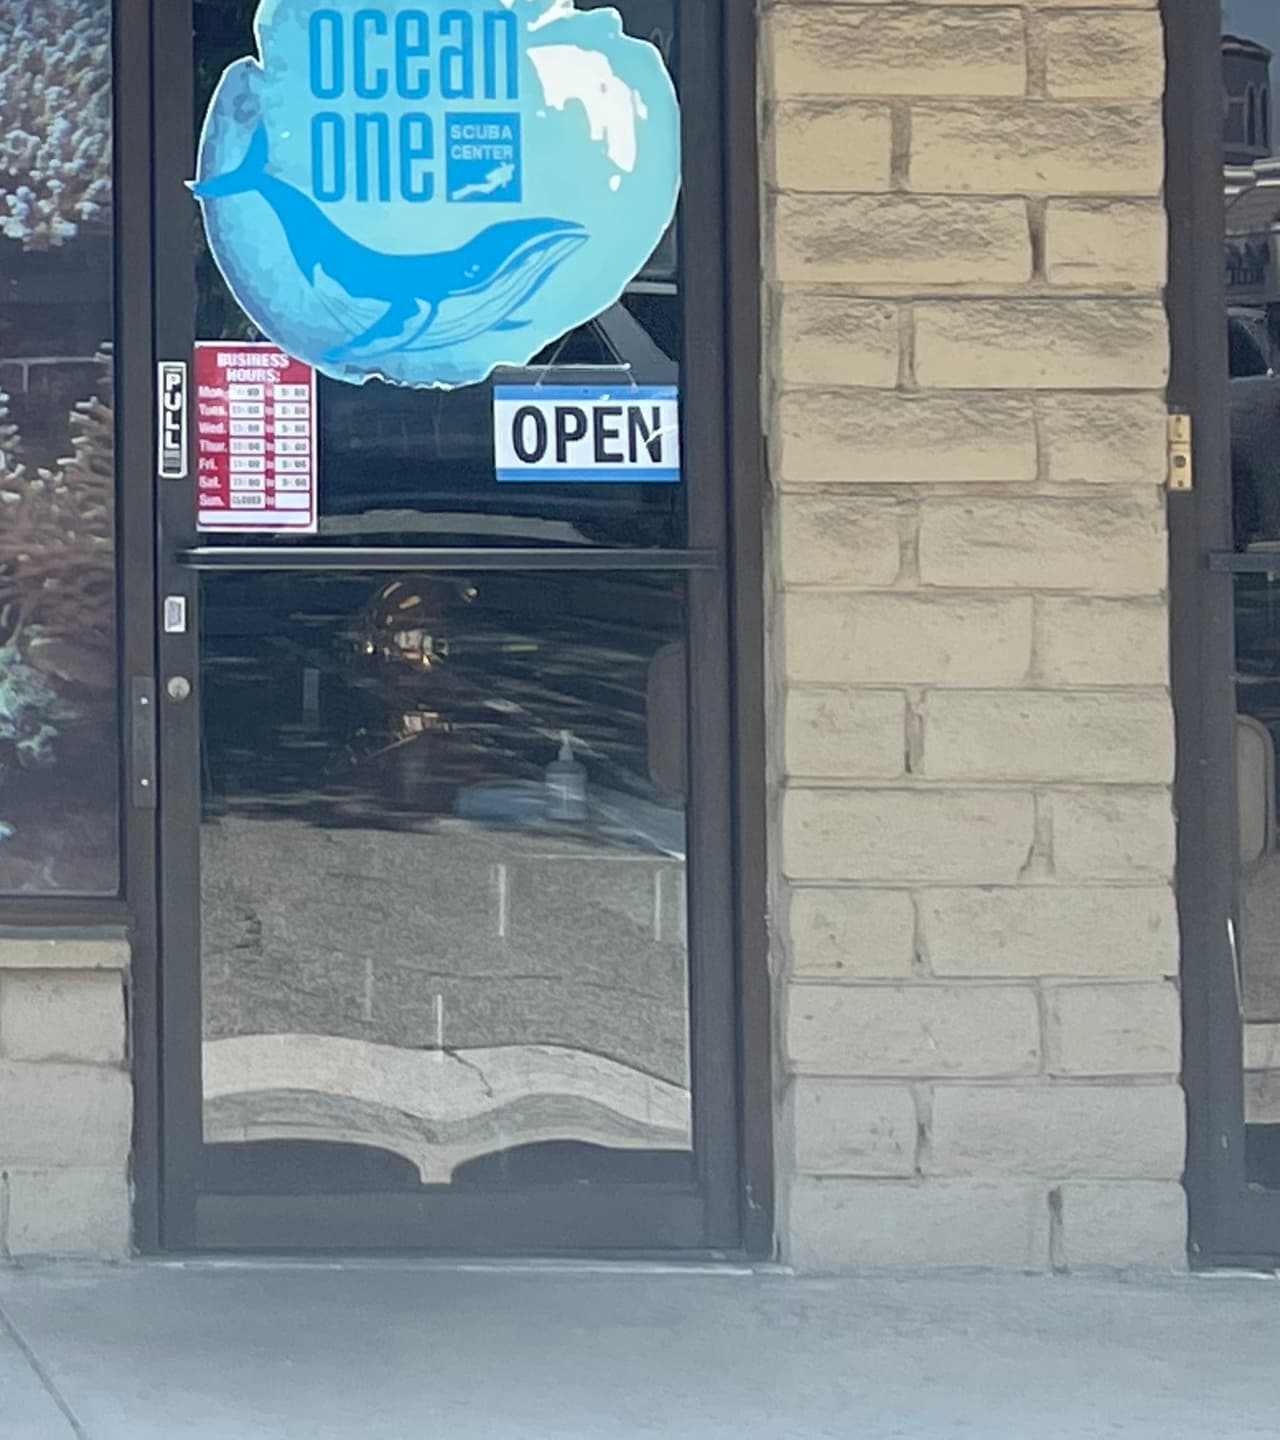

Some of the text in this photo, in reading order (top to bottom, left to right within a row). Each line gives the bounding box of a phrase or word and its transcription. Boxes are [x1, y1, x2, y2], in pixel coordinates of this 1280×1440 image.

[309, 8, 519, 100] ocean
[450, 124, 513, 140] SCUBA
[311, 111, 435, 203] one
[450, 144, 513, 160] CENTER
[217, 353, 290, 368] BUSINESS
[226, 369, 281, 382] HOURS:
[164, 373, 182, 449] PULL
[512, 405, 663, 464] OPEN
